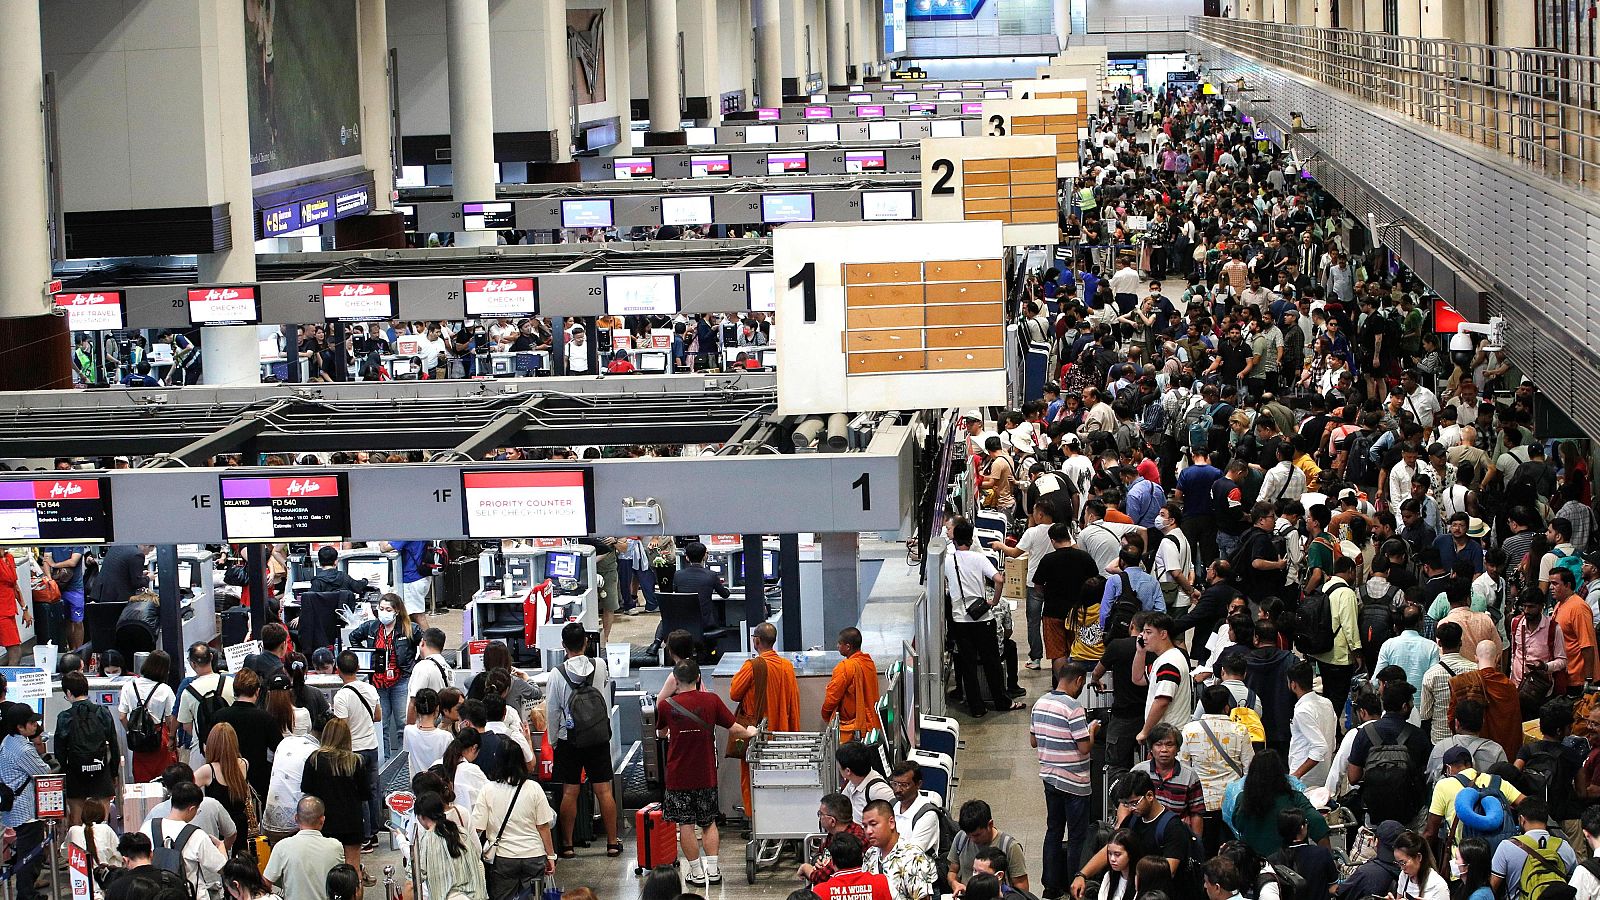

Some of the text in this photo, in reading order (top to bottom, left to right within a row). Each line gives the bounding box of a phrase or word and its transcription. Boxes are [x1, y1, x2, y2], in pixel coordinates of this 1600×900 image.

[988, 114, 1006, 137] 3
[756, 158, 765, 166] 4F
[832, 156, 843, 164] 4G
[910, 154, 921, 162] 4H
[602, 162, 612, 171] 4D
[678, 160, 689, 168] 4E
[931, 158, 955, 195] 2
[650, 204, 659, 213] 3F
[748, 202, 758, 211] 3G
[849, 200, 859, 208] 3H
[451, 211, 461, 219] 3D
[549, 207, 559, 216] 3E
[588, 287, 602, 296] 2G
[732, 284, 745, 292] 2H
[447, 291, 459, 300] 2F
[788, 262, 817, 324] 1
[171, 299, 184, 308] 2D
[308, 295, 320, 303] 2E
[487, 296, 525, 304] CHECK-IN
[210, 304, 247, 312] CHECK-IN
[344, 300, 382, 308] CHECK-IN
[50, 482, 82, 498] AirAsia
[287, 480, 320, 496] AirAsia
[852, 473, 871, 511] 1
[432, 489, 452, 503] 1F
[191, 494, 211, 508] 1E
[480, 499, 572, 508] PRIORITY COUNTER
[476, 509, 497, 517] SELF
[81, 764, 102, 772] PUMA
[830, 886, 840, 894] I'M
[848, 885, 872, 893] WORLD
